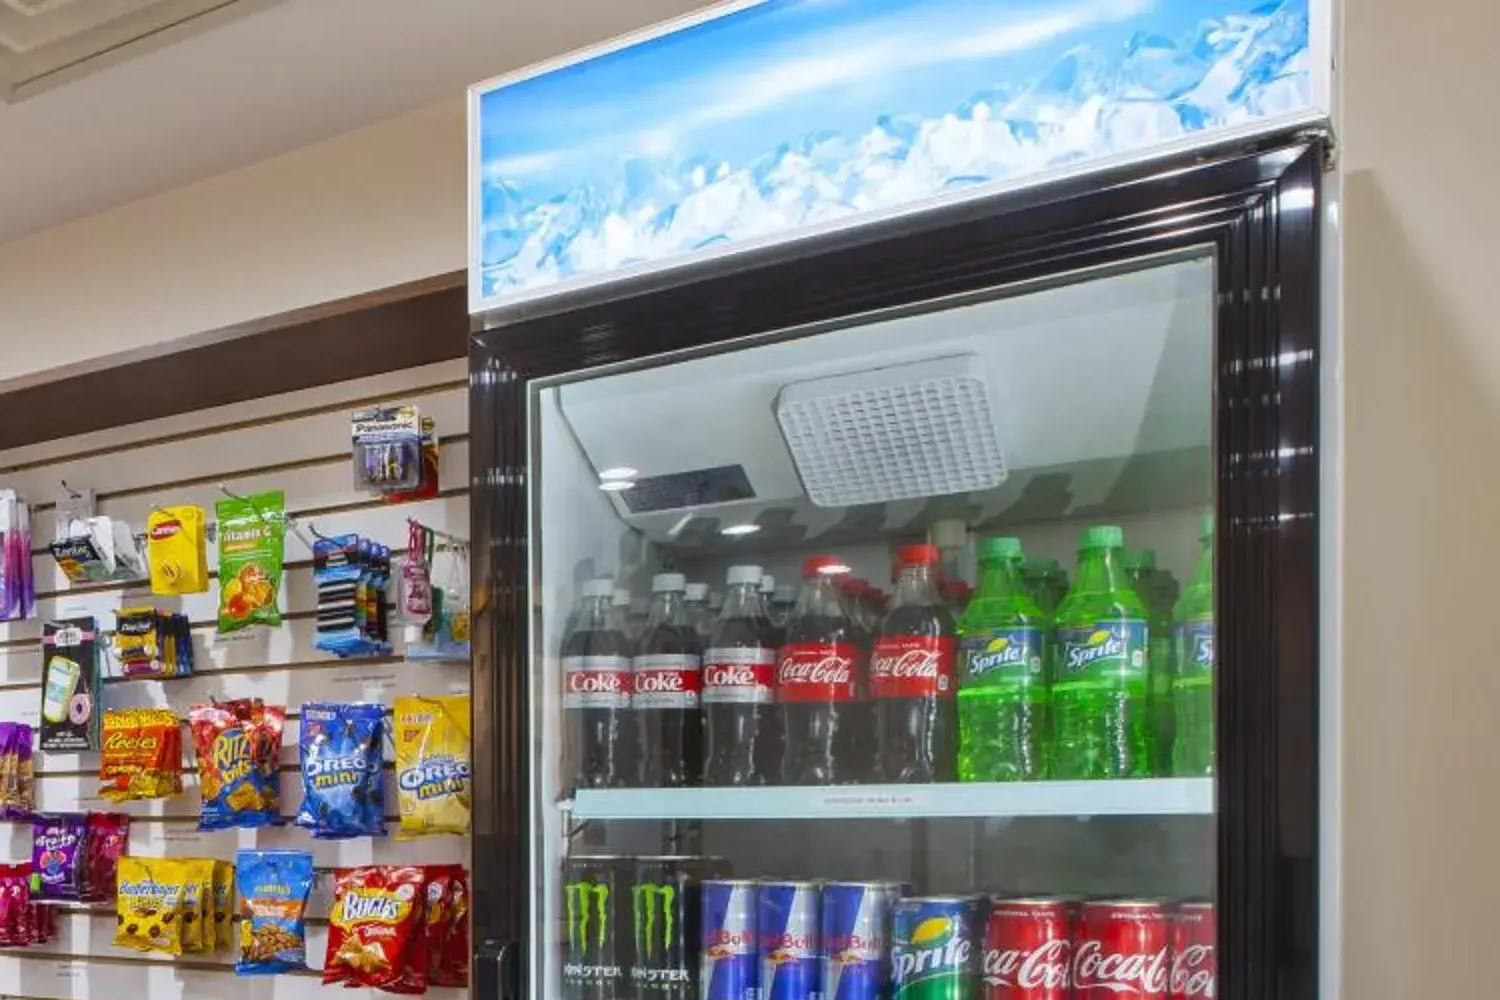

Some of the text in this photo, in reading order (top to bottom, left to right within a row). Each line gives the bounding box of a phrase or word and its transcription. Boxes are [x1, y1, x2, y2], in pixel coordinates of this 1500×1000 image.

[969, 647, 1027, 674] Sprite
[1067, 639, 1123, 669] Sprite
[570, 671, 621, 692] Coke
[635, 671, 683, 692] Coke
[704, 666, 755, 687] Coke
[212, 733, 252, 768] RITZ
[891, 928, 971, 981] Sprite
